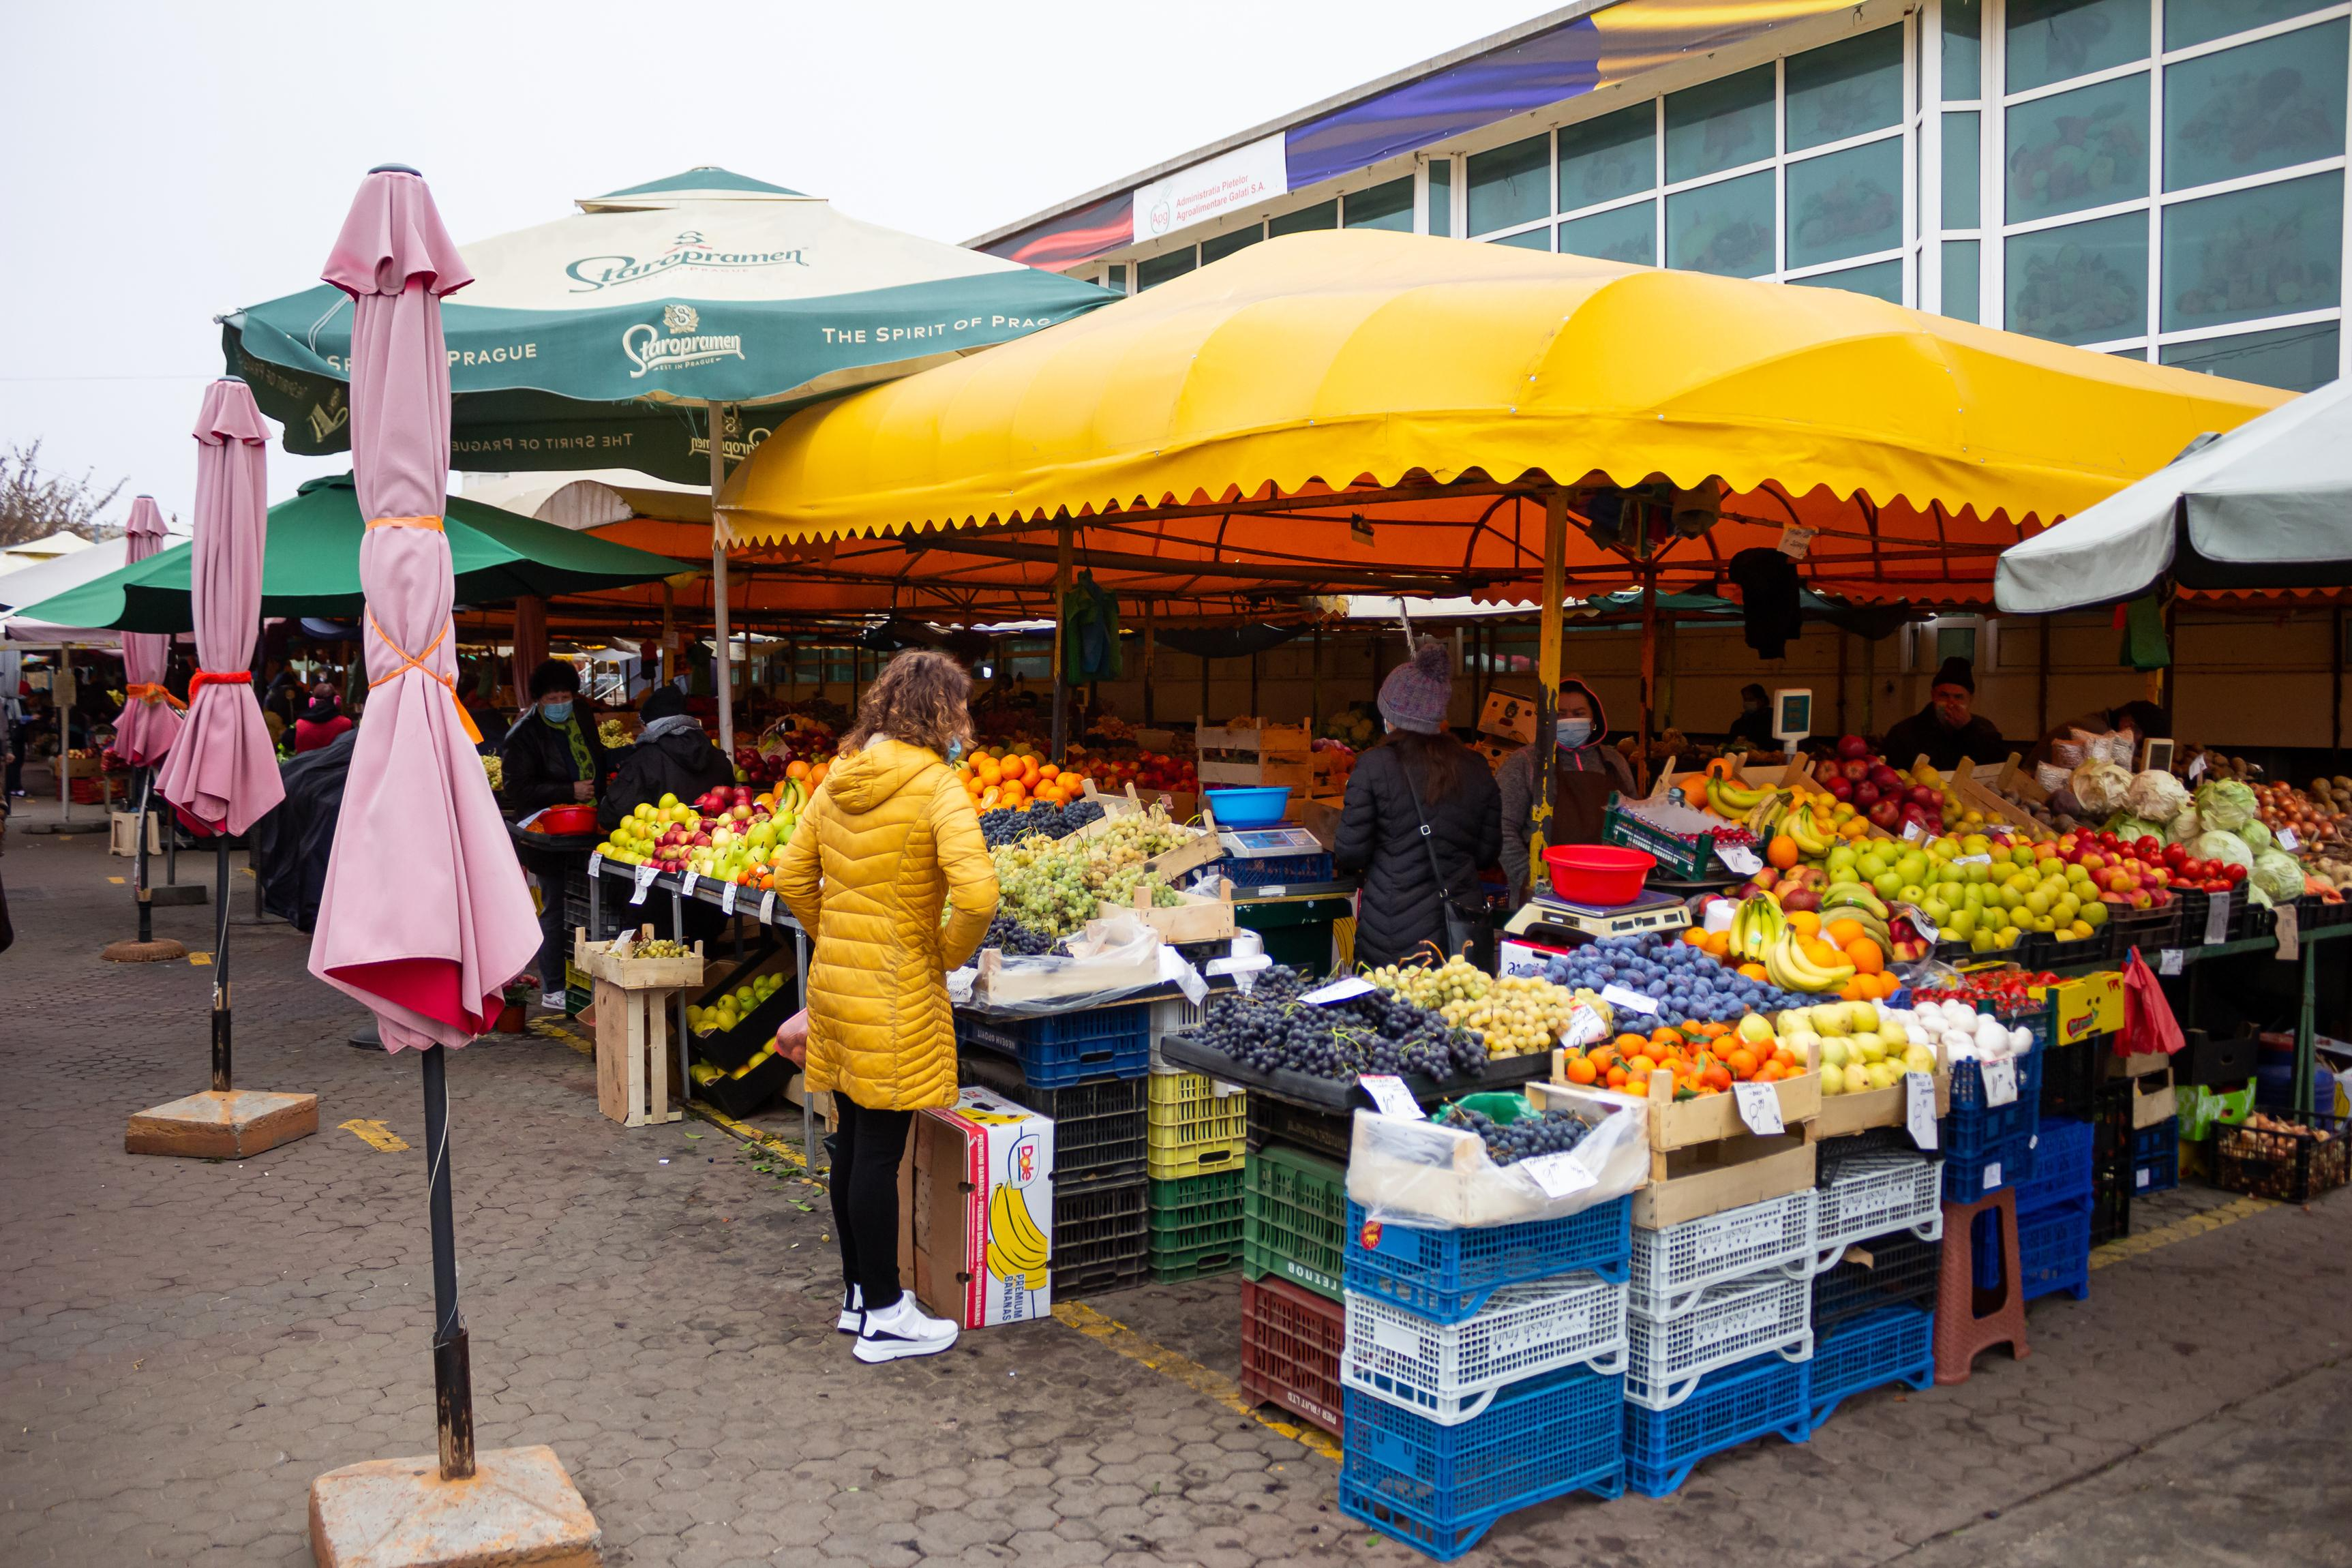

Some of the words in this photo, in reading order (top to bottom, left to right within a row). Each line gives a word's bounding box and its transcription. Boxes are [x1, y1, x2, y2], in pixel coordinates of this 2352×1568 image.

[1176, 185, 1220, 208] Administratia
[1222, 175, 1248, 190] Pietelor
[1177, 195, 1228, 221] Agroalimentare
[1229, 187, 1249, 201] Galati
[1251, 181, 1266, 194] S.A.
[1152, 211, 1168, 224] Apg
[565, 247, 810, 293] Staropramen
[821, 327, 866, 344] THE
[876, 323, 946, 342] SPIRIT
[954, 317, 982, 331] OF
[992, 315, 1052, 329] PRAG
[447, 343, 537, 367] PRAGUE
[622, 323, 745, 378] Staropramen
[685, 358, 714, 369] PRAGUE
[1021, 1145, 1034, 1181] Dole
[1002, 1276, 1013, 1321] BANANAS
[1013, 1273, 1025, 1318] PREMIUM
[1493, 1329, 1520, 1346] fruit
[1287, 1391, 1300, 1406] LTD
[1301, 1398, 1321, 1416] FRUIT
[1323, 1409, 1336, 1425] PIER
